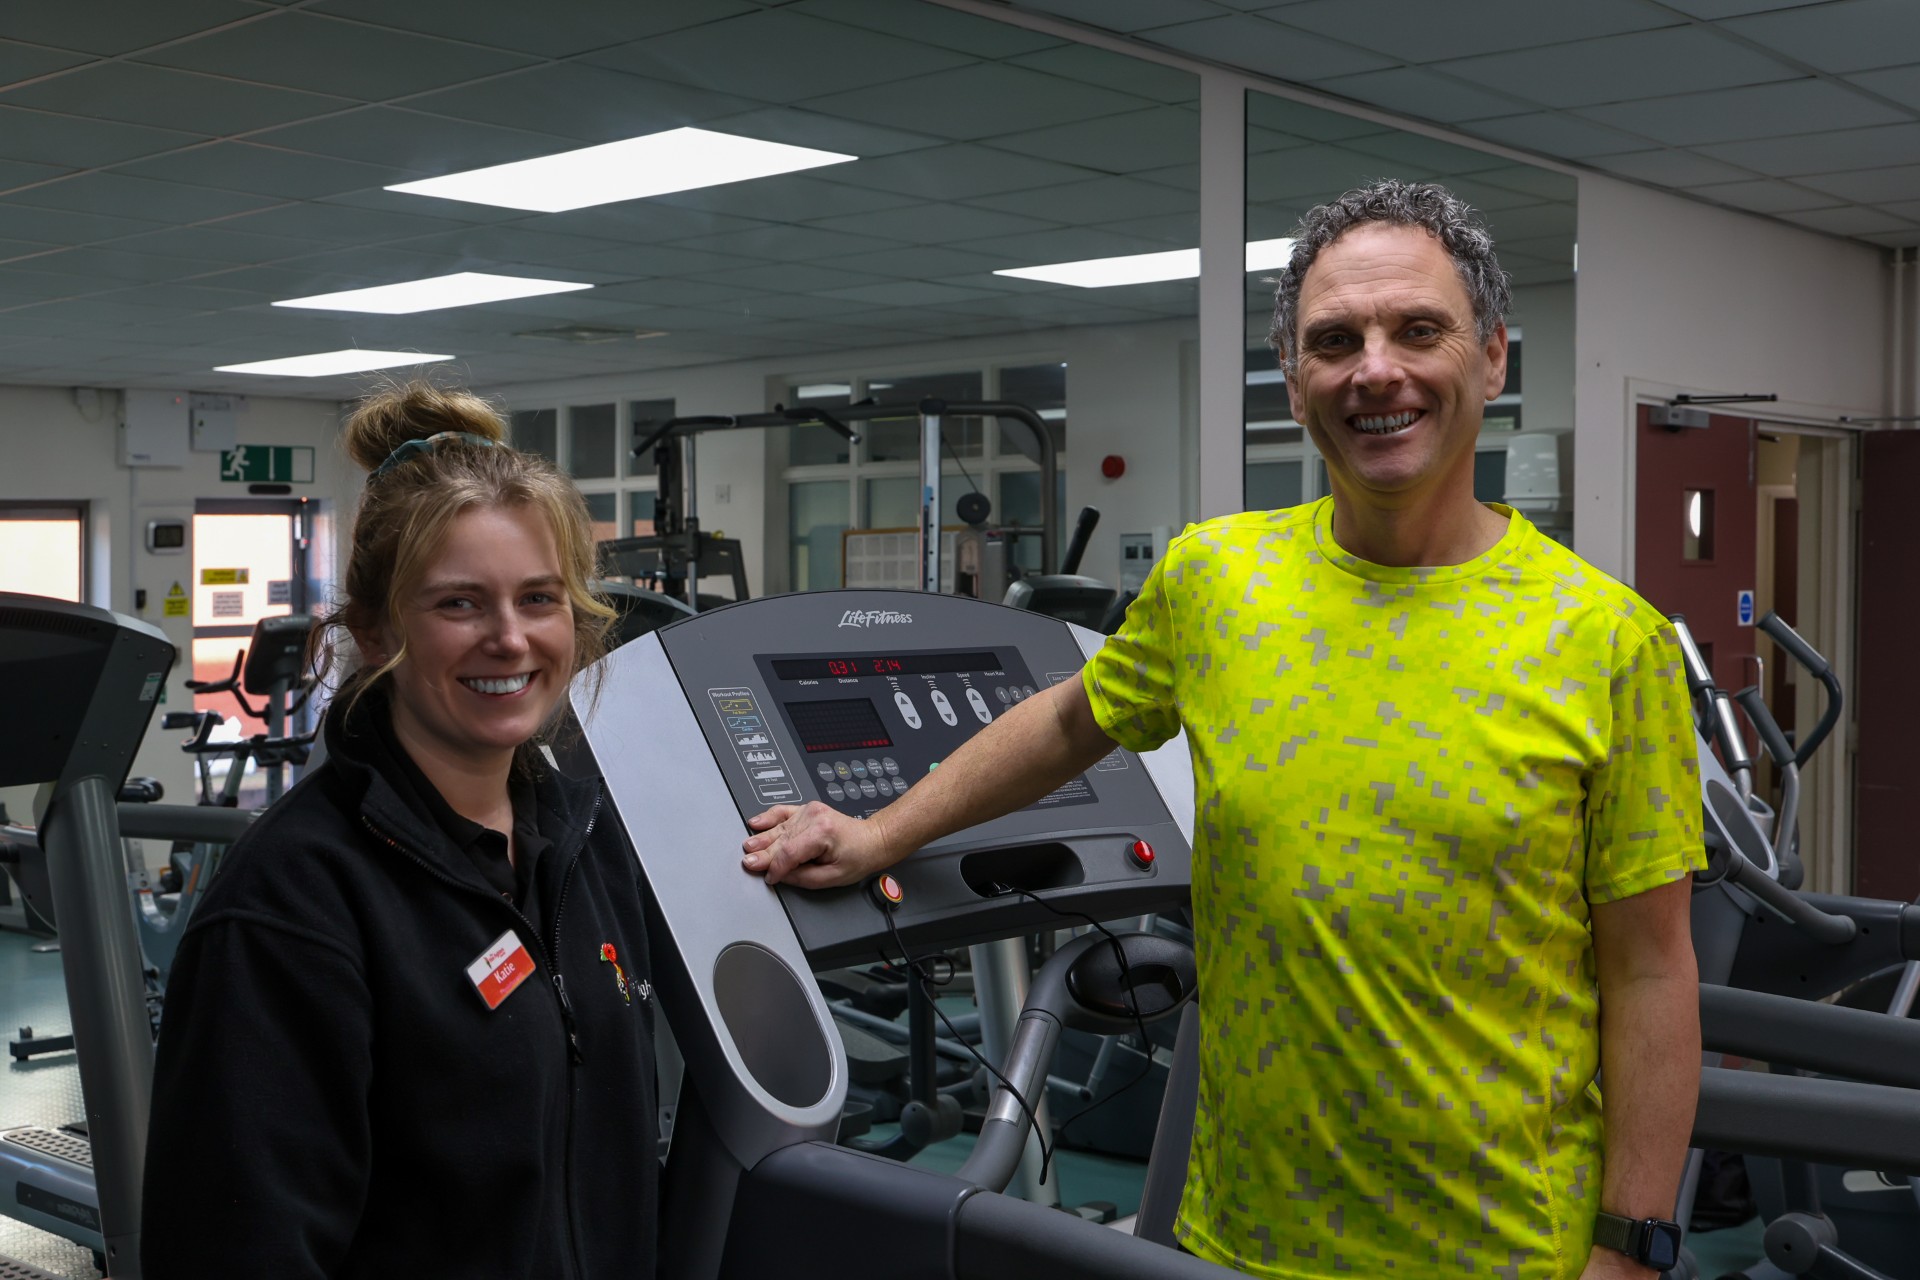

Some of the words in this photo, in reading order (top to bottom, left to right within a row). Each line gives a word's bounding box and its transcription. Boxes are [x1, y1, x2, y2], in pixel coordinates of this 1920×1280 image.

[1000, 690, 1006, 699] 1
[1013, 690, 1020, 699] 2
[493, 962, 516, 984] Katie
